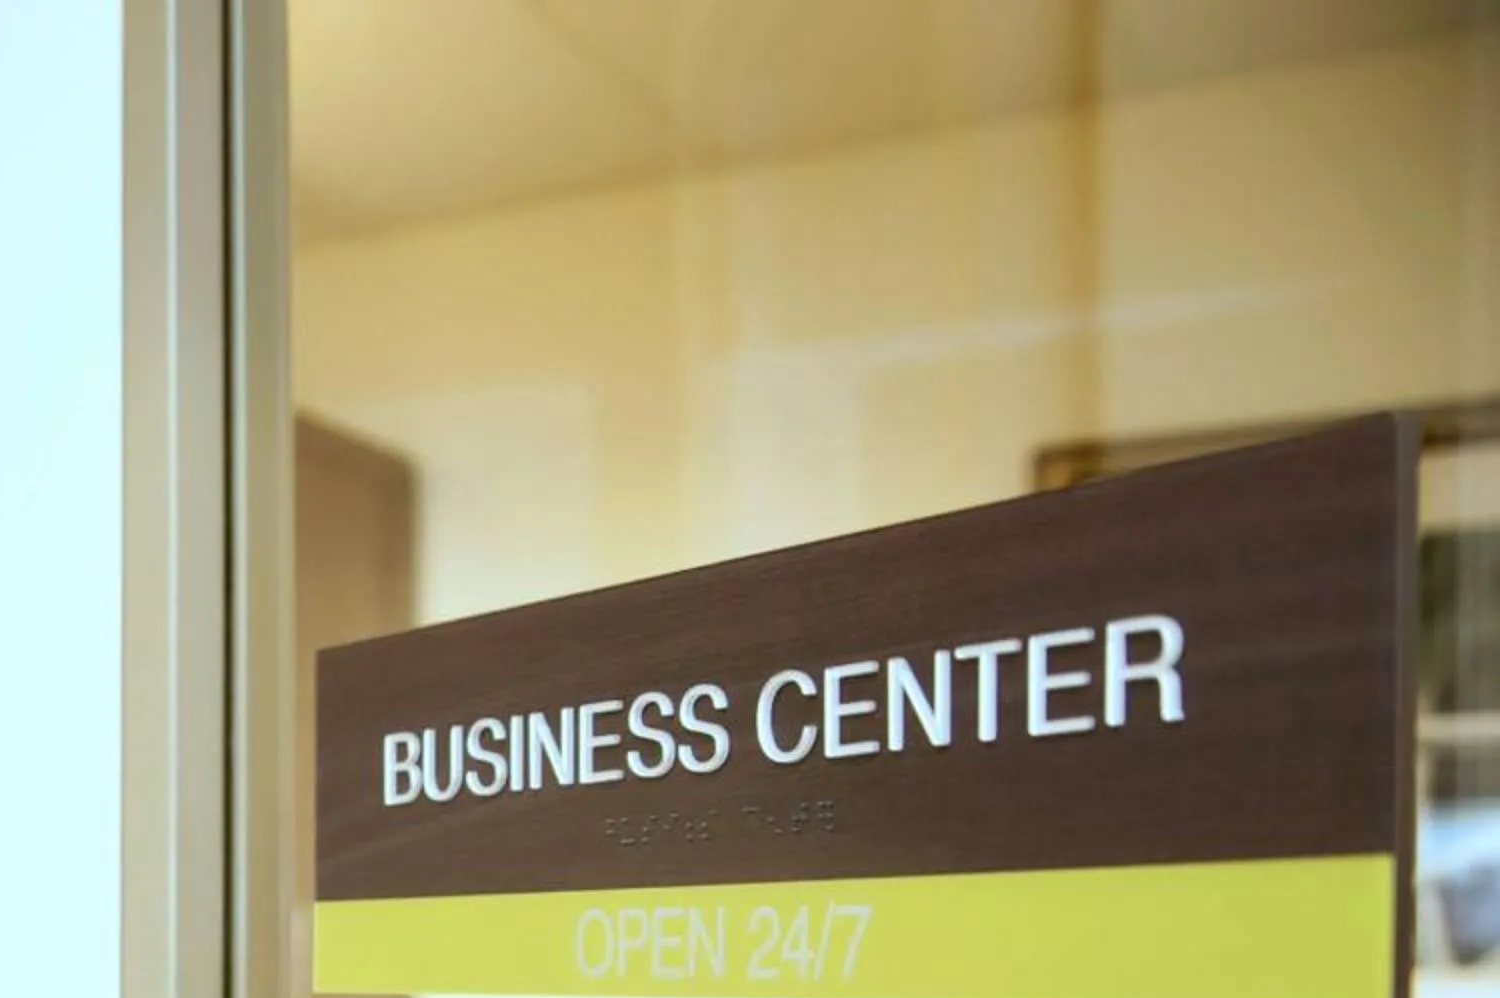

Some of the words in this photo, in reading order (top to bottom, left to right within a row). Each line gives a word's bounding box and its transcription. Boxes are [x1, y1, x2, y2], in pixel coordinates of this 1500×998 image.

[383, 683, 730, 806] BUSINESS
[755, 614, 1185, 765] CENTER
[575, 905, 726, 981] OPEN
[746, 900, 872, 981] 24/7
